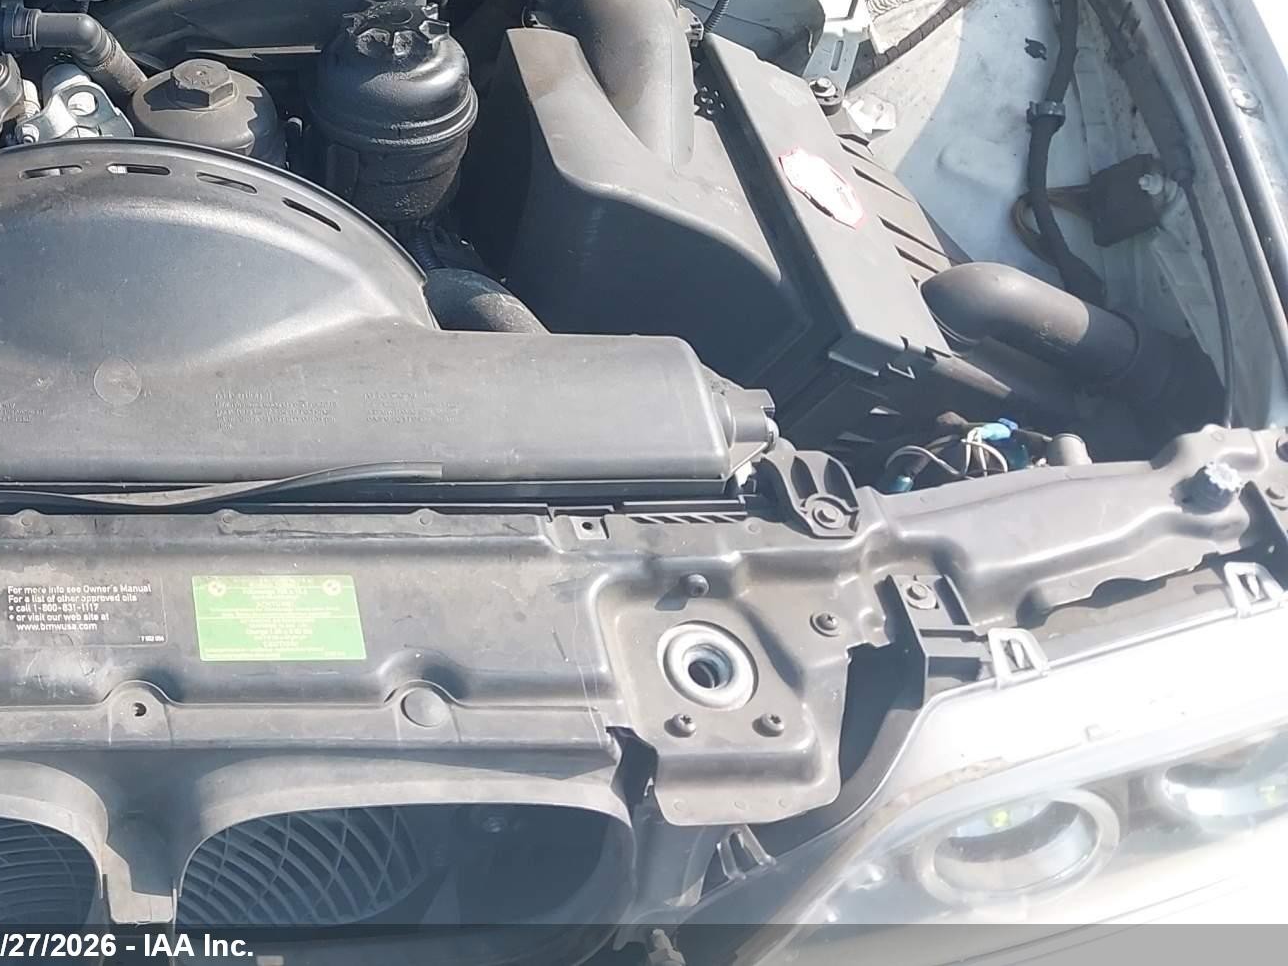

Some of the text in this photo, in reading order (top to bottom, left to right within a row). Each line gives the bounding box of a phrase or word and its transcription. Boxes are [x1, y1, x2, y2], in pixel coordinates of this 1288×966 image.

[8, 586, 22, 594] For
[24, 586, 46, 594] more
[48, 586, 64, 594] info
[83, 584, 118, 593] Owner's
[120, 584, 152, 592] Manual
[8, 594, 22, 603] For
[32, 594, 45, 602] list
[46, 594, 55, 602] of
[57, 594, 79, 602] other
[81, 593, 120, 603] approved
[122, 593, 137, 602] oils
[16, 603, 99, 612] call 1-800-831-1117
[27, 613, 45, 621] visit
[63, 612, 81, 621] web
[83, 612, 99, 620] site
[101, 612, 109, 621] at
[16, 622, 97, 631] www.bmwusa.com
